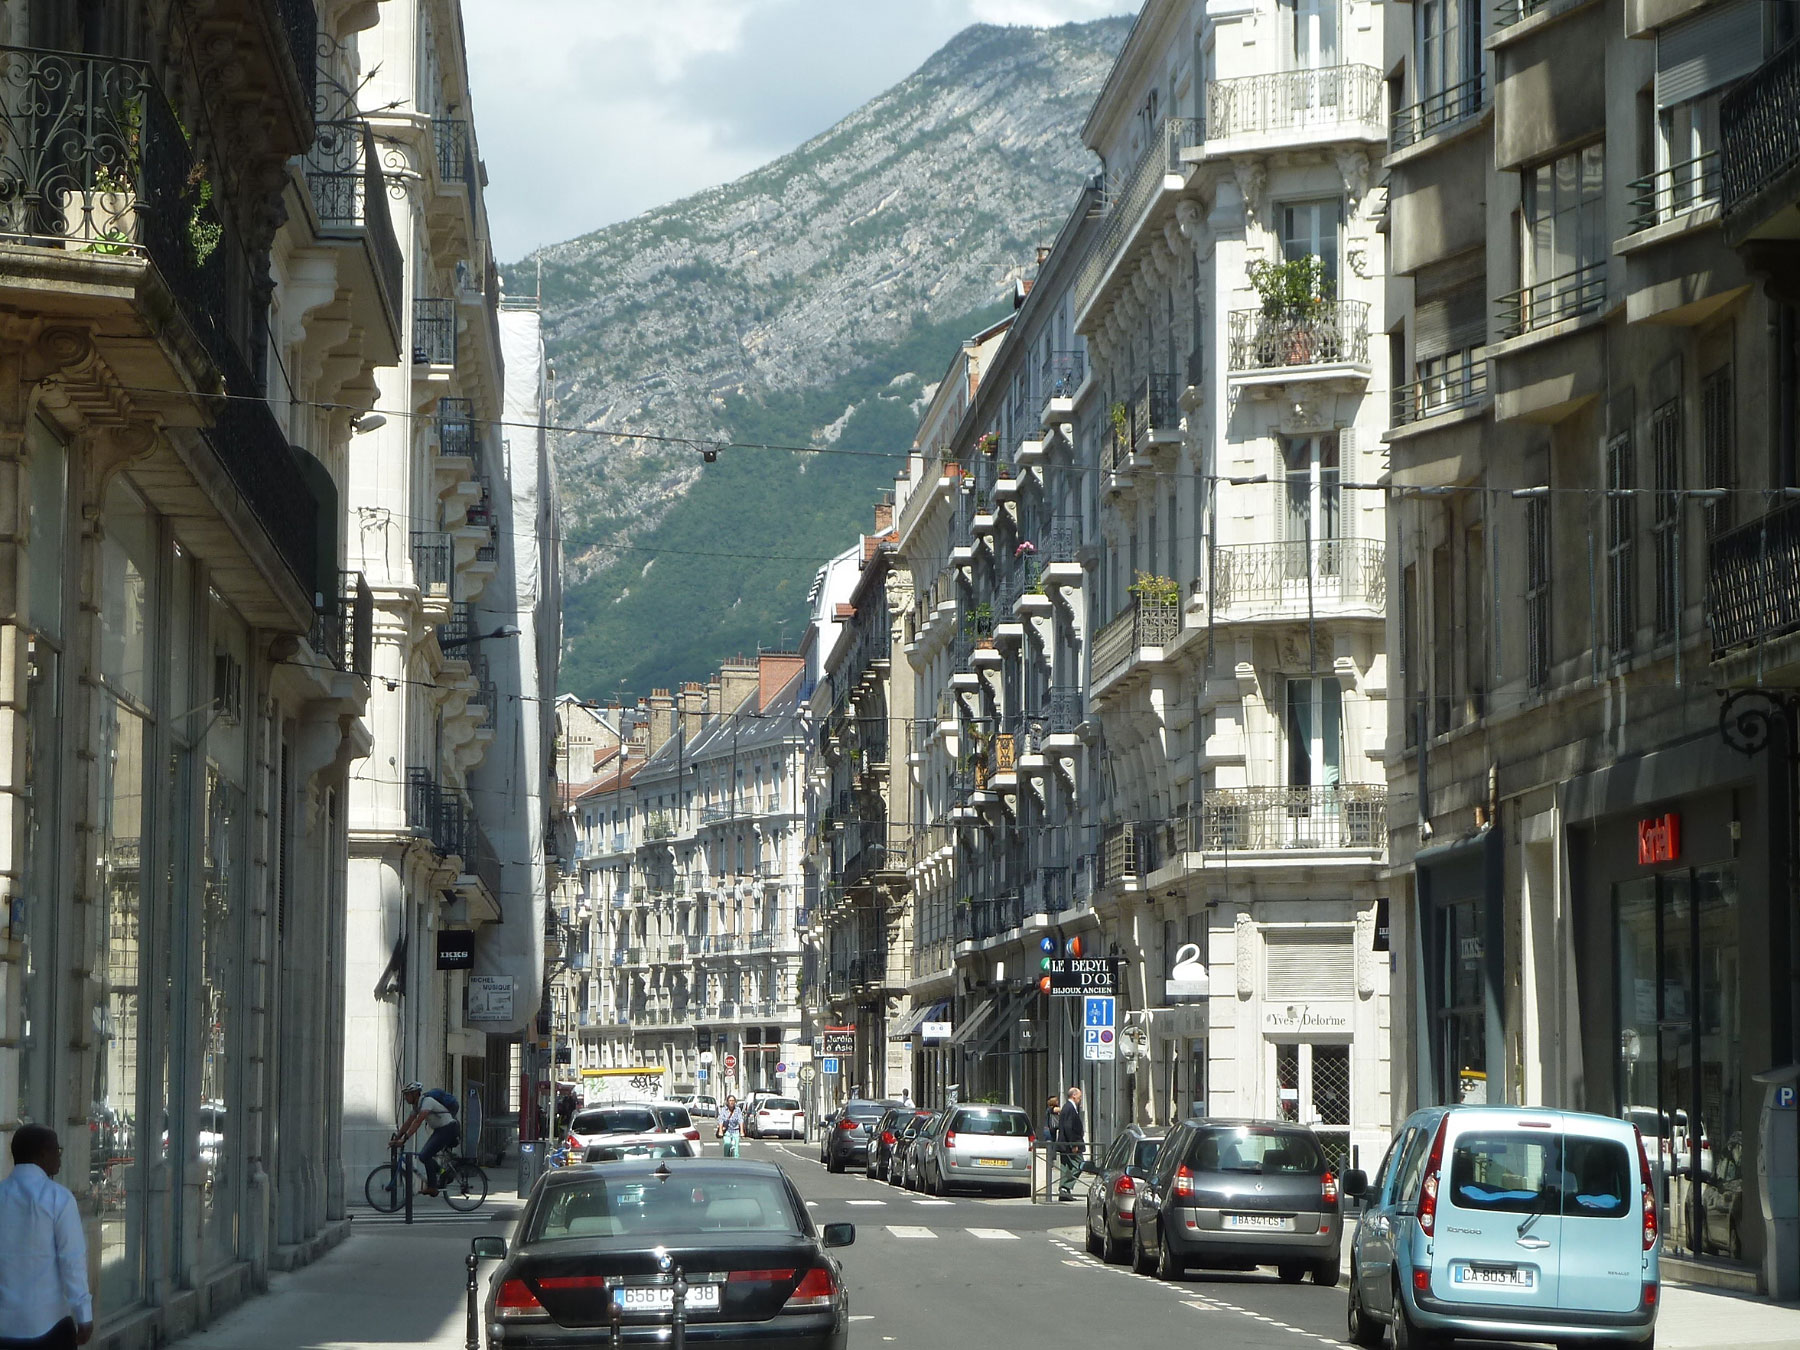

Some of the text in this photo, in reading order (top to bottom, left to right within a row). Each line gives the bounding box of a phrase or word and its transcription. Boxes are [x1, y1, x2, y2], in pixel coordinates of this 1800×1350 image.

[440, 951, 469, 959] IKKS
[1052, 959, 1109, 972] LE BERYL
[1271, 1013, 1346, 1026] Yves Delorme
[827, 1034, 853, 1043] Jardin
[835, 1043, 853, 1052] Asie
[1781, 1087, 1793, 1106] P
